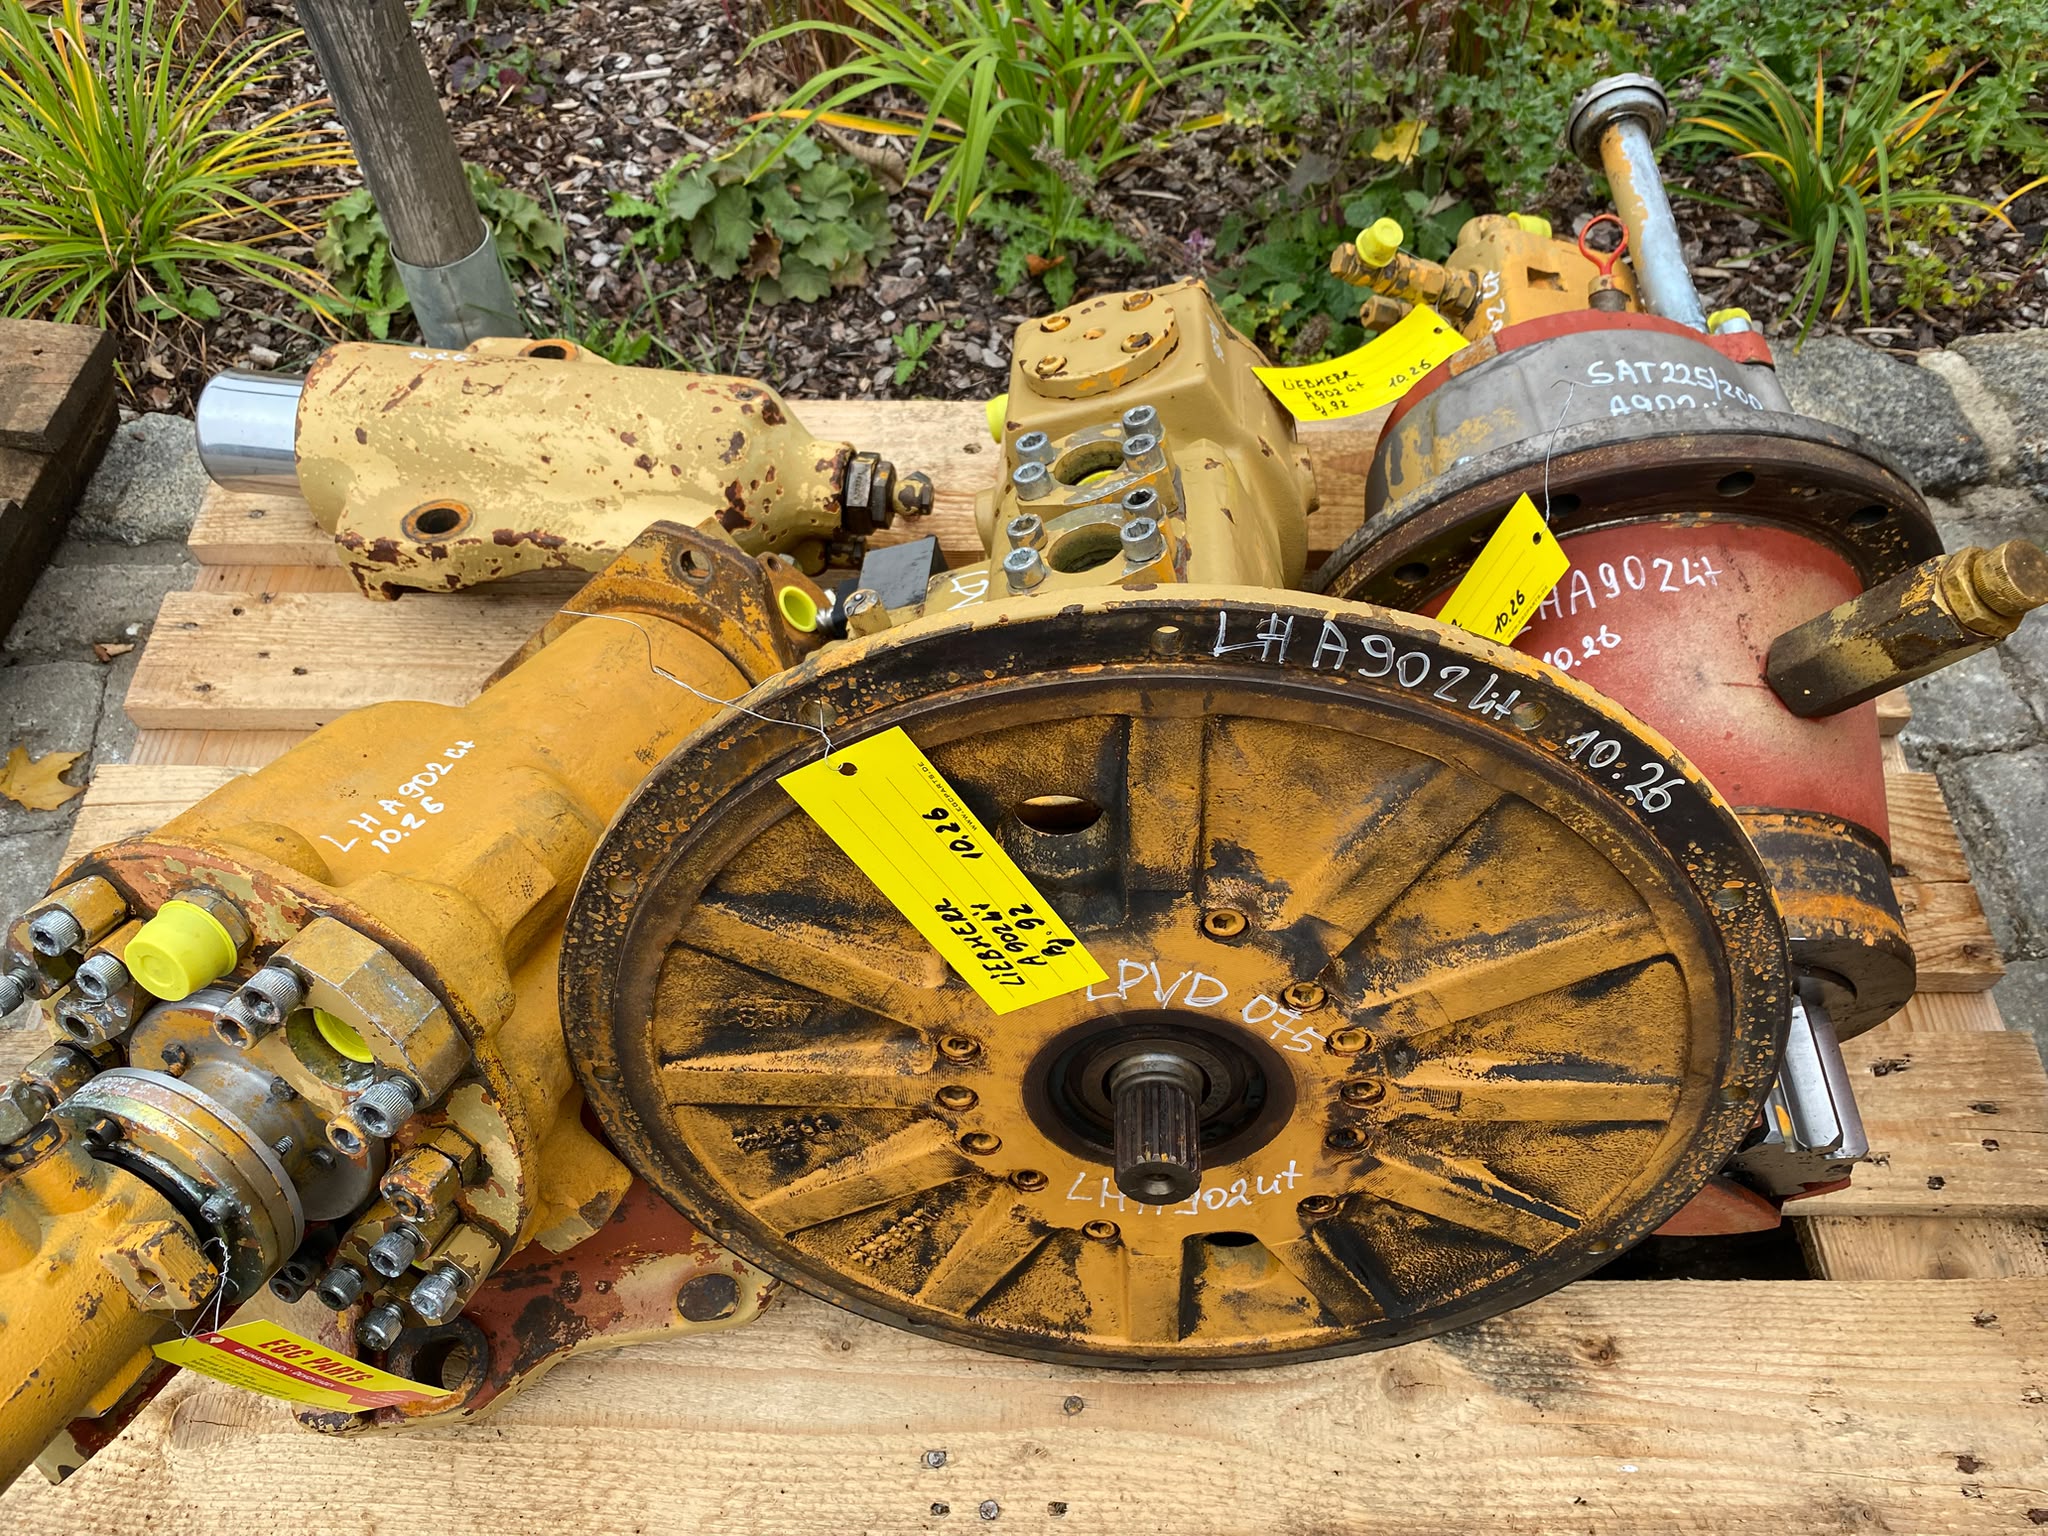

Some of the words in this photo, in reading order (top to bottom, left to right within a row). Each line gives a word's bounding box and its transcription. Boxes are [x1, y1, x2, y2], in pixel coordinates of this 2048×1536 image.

[1389, 359, 1432, 388] 10.26
[1494, 589, 1525, 635] 10.26
[1566, 730, 1686, 813] 10.26
[371, 796, 445, 854] 10.26
[922, 807, 983, 859] 10.26
[935, 898, 1025, 986] LIEBHERR
[258, 1339, 313, 1359] EGC
[301, 1357, 374, 1382] PARTS
